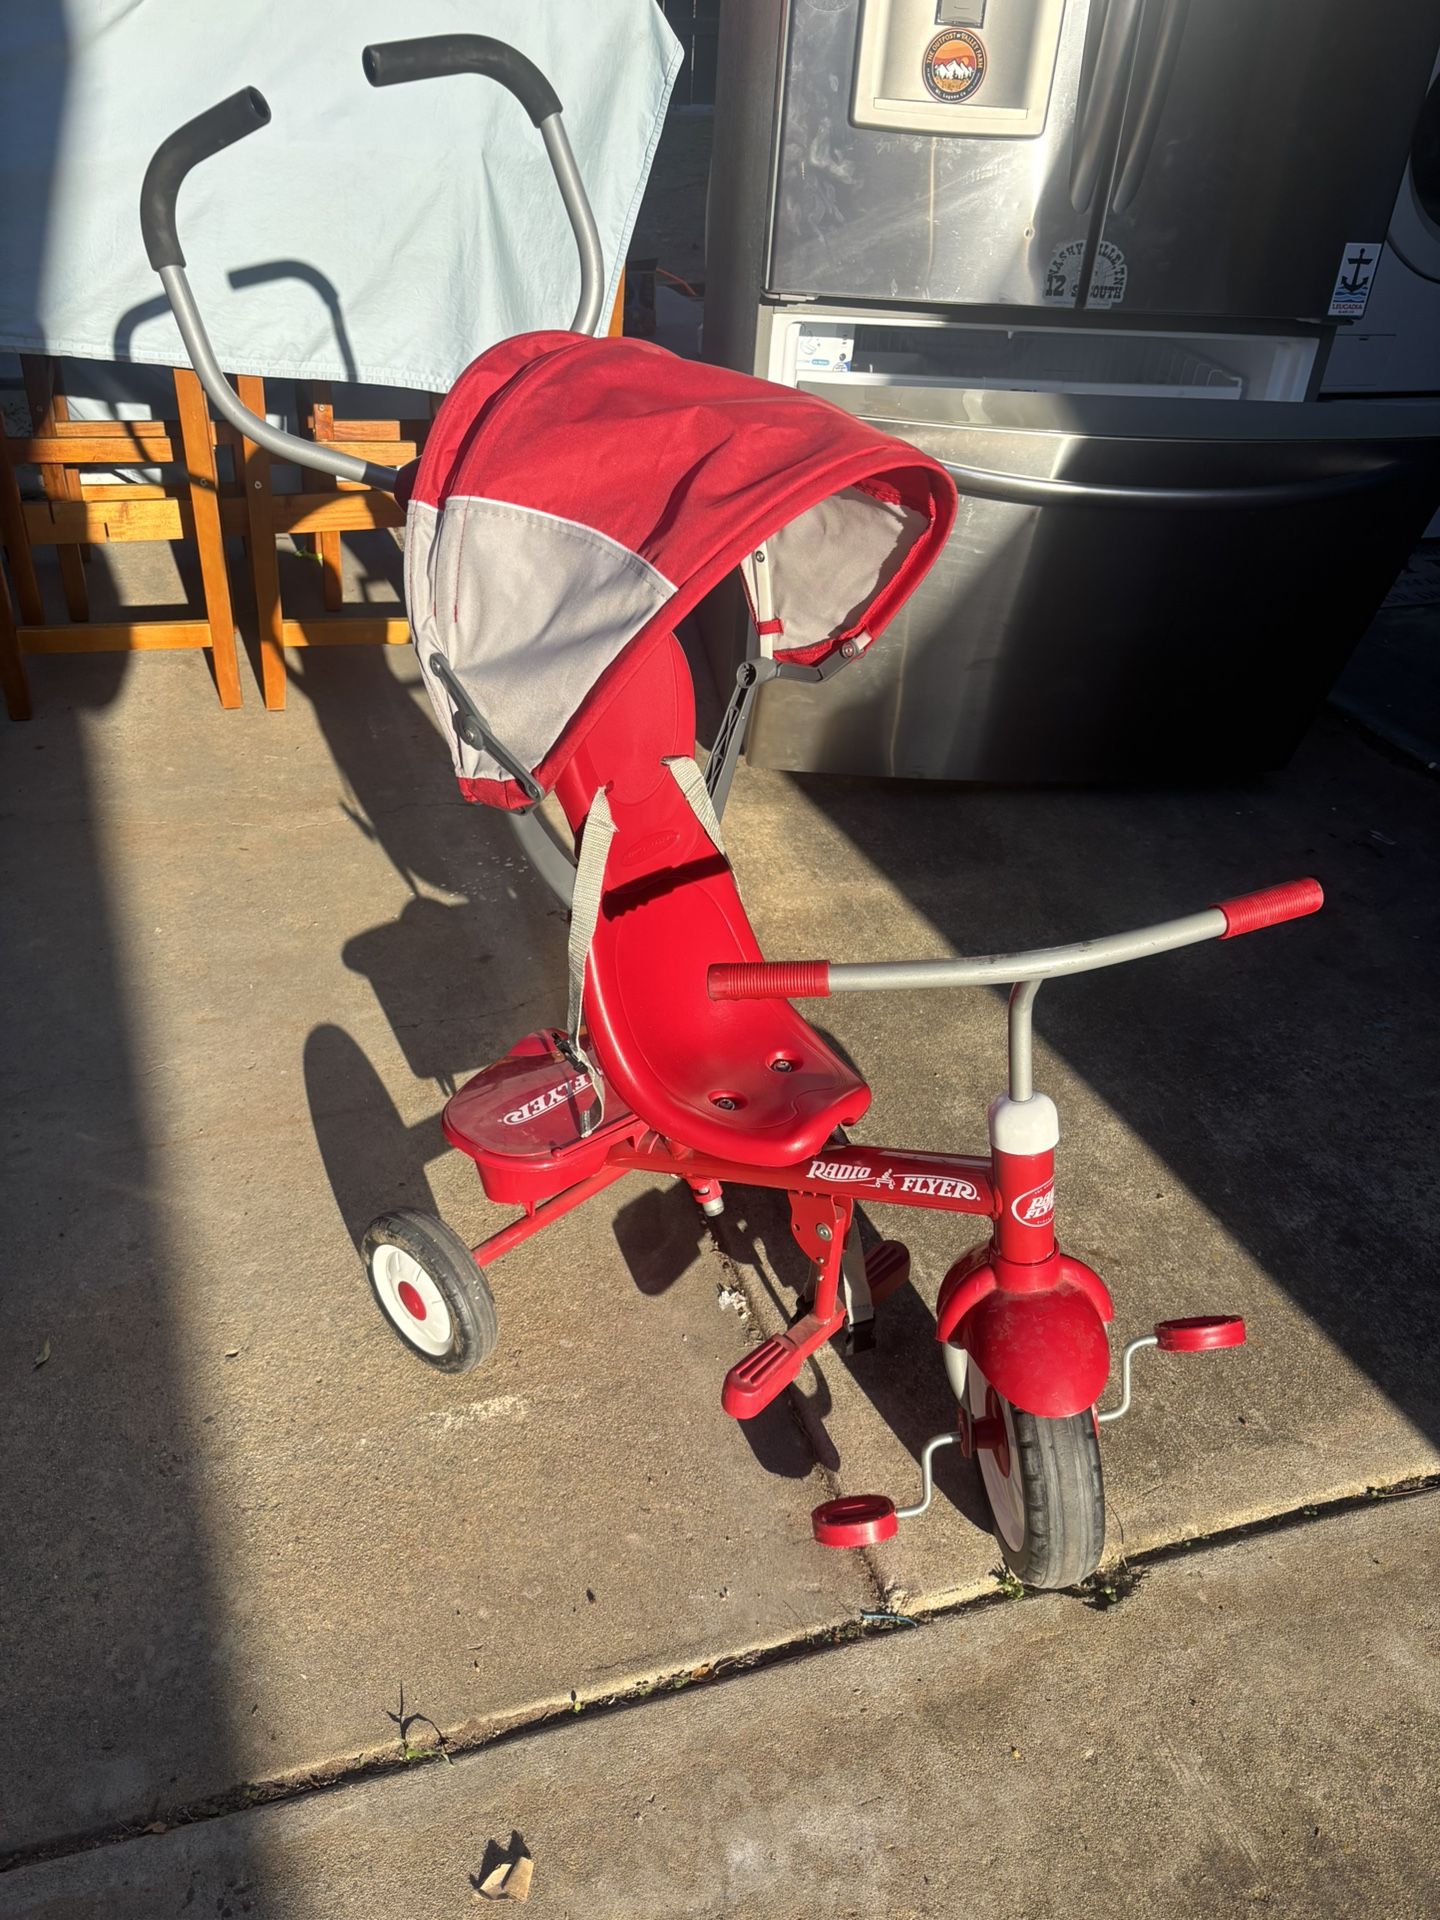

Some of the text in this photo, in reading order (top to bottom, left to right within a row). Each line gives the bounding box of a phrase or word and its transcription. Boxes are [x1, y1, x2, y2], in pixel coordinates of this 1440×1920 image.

[927, 49, 936, 63] THE
[932, 32, 956, 52] OUTPOST
[961, 33, 979, 51] VALLEY
[1045, 274, 1066, 297] 12
[503, 1074, 589, 1125] FLYER
[806, 1160, 977, 1200] RADIO FLYER
